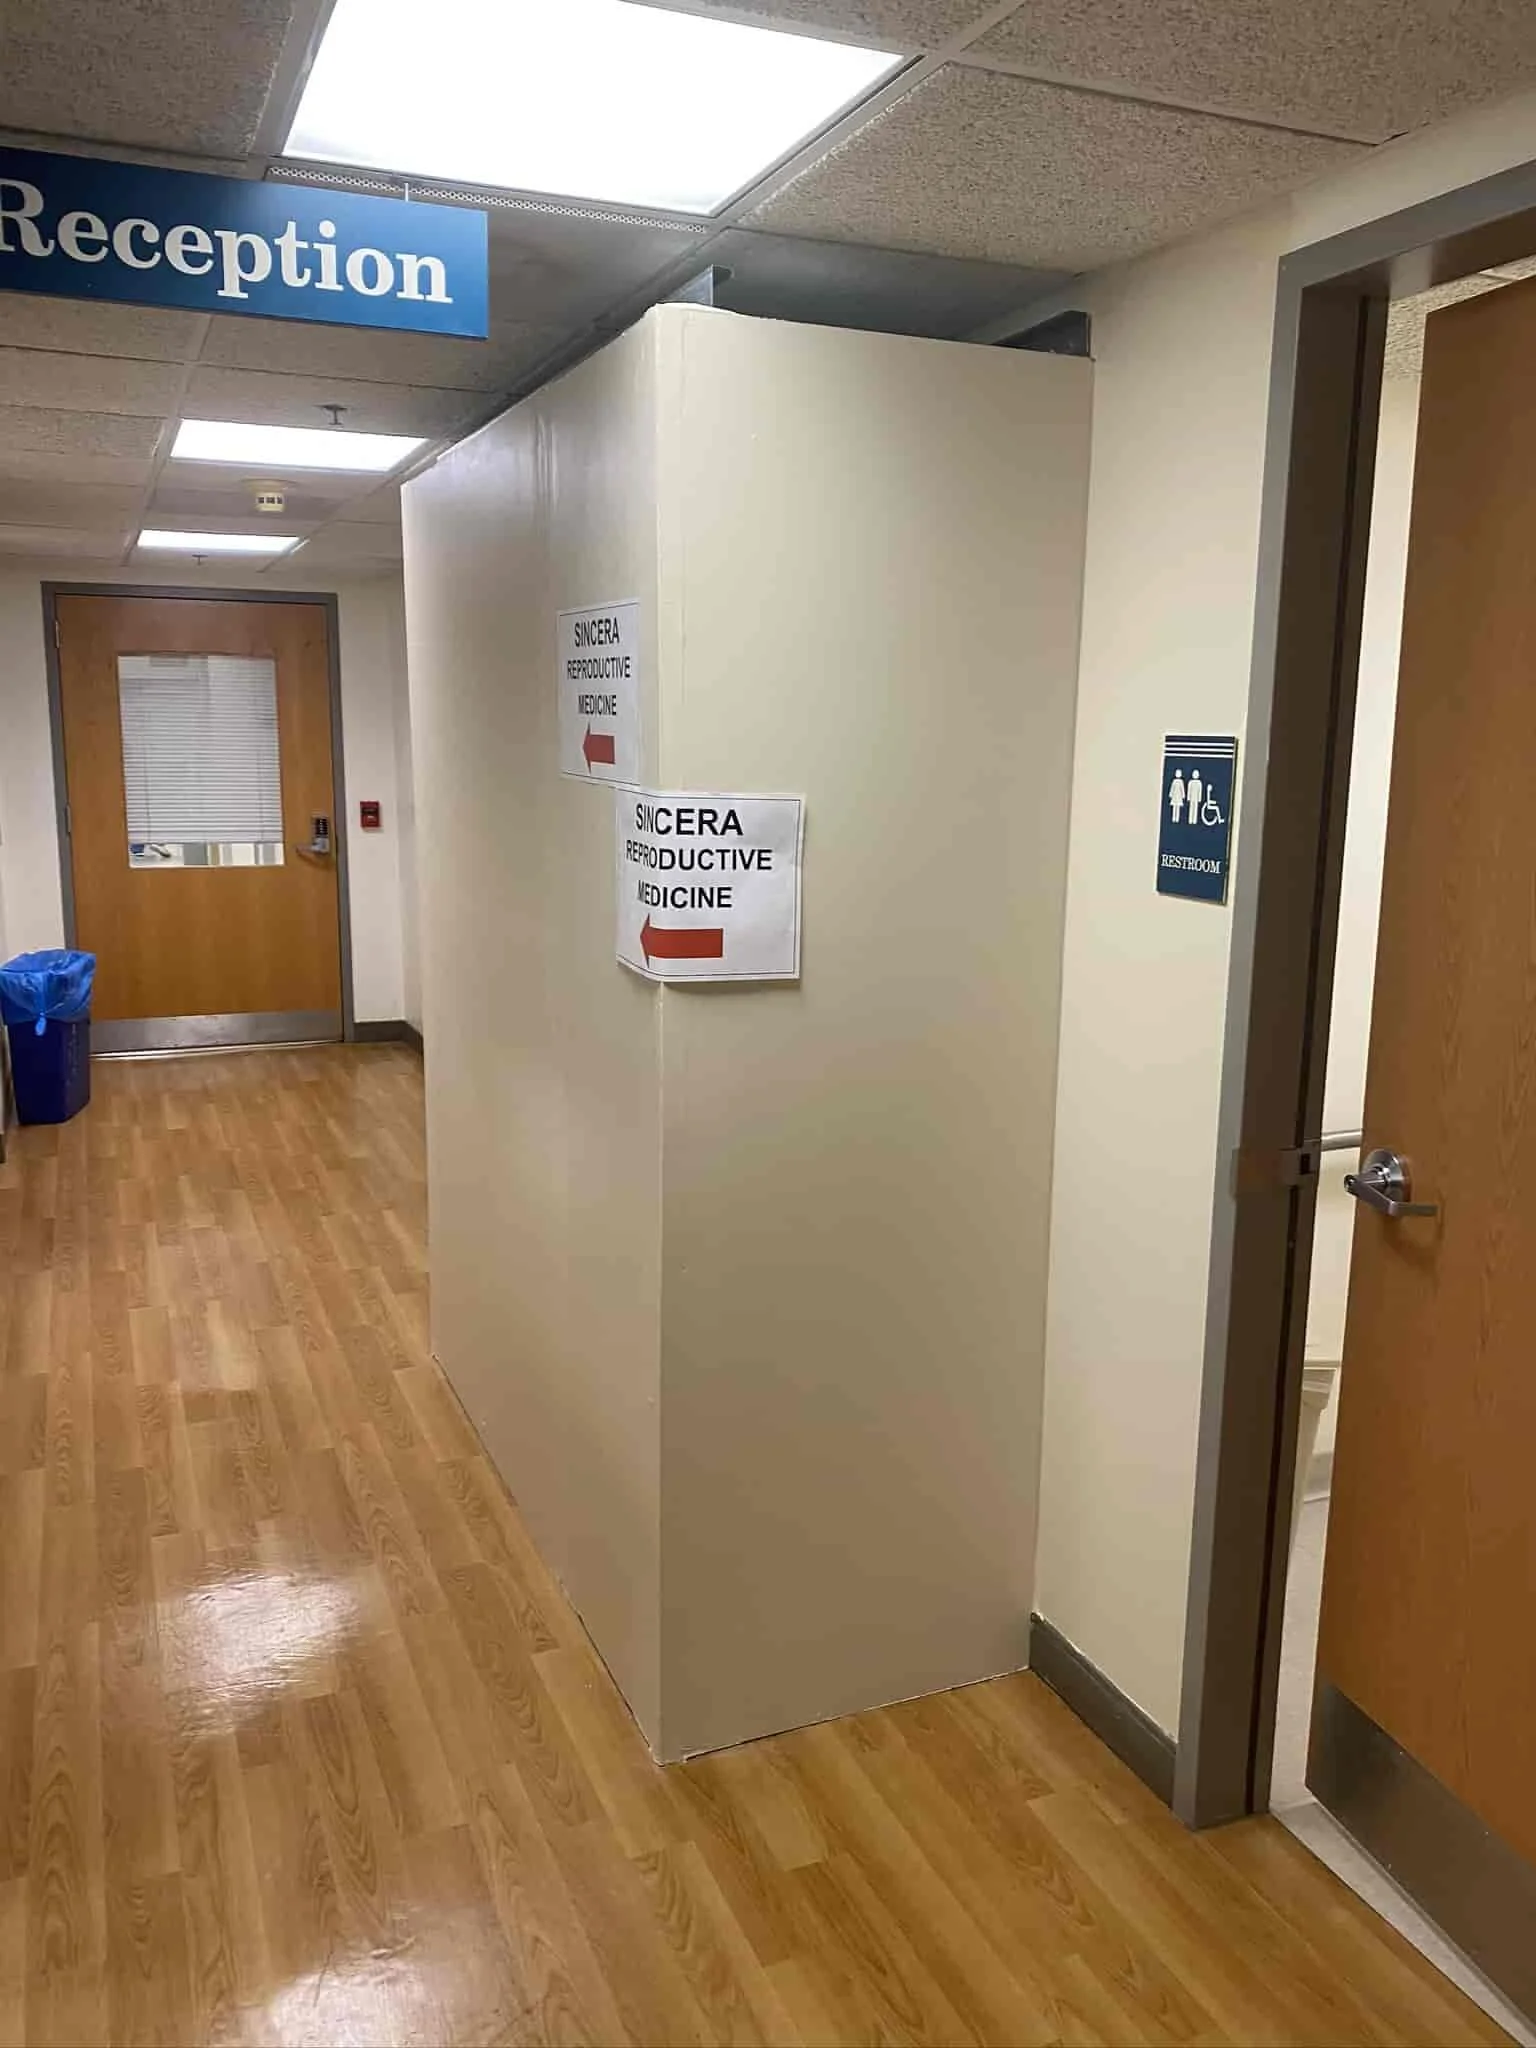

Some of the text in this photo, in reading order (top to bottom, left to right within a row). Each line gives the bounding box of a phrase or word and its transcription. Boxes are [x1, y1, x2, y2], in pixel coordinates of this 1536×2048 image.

[0, 178, 454, 304] Reception
[574, 617, 620, 648] SINCERA
[567, 655, 631, 682] REPRODUCTIVE
[578, 694, 617, 717] MEDICINE
[635, 802, 744, 837] SINCERA
[626, 839, 773, 871] REPRODUCTIVE
[1161, 854, 1221, 874] RESTROOM
[638, 879, 732, 909] MEDICINE
